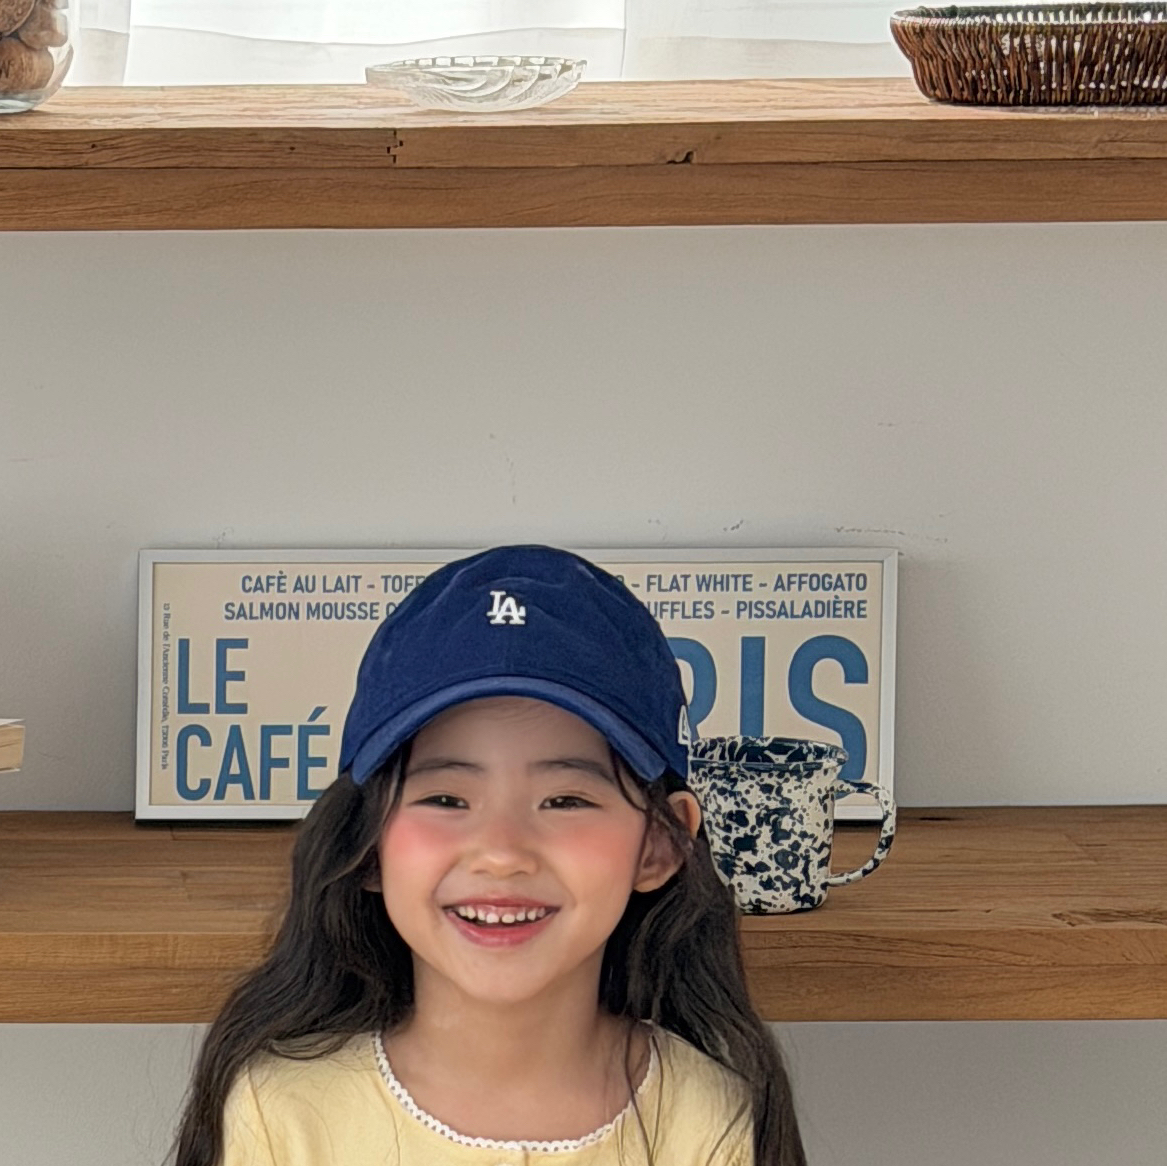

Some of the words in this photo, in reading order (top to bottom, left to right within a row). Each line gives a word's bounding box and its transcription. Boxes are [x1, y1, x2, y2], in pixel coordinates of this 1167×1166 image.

[293, 575, 316, 593] AU
[322, 575, 363, 593] LAIT
[646, 574, 691, 592] FLAT
[696, 574, 753, 592] WHITE
[773, 573, 868, 592] AFFOGATO
[224, 602, 300, 620] SALMON
[306, 602, 380, 620] MOUSSE
[486, 590, 526, 625] LA
[178, 638, 248, 714] LE
[176, 706, 330, 801] CAFÉ
